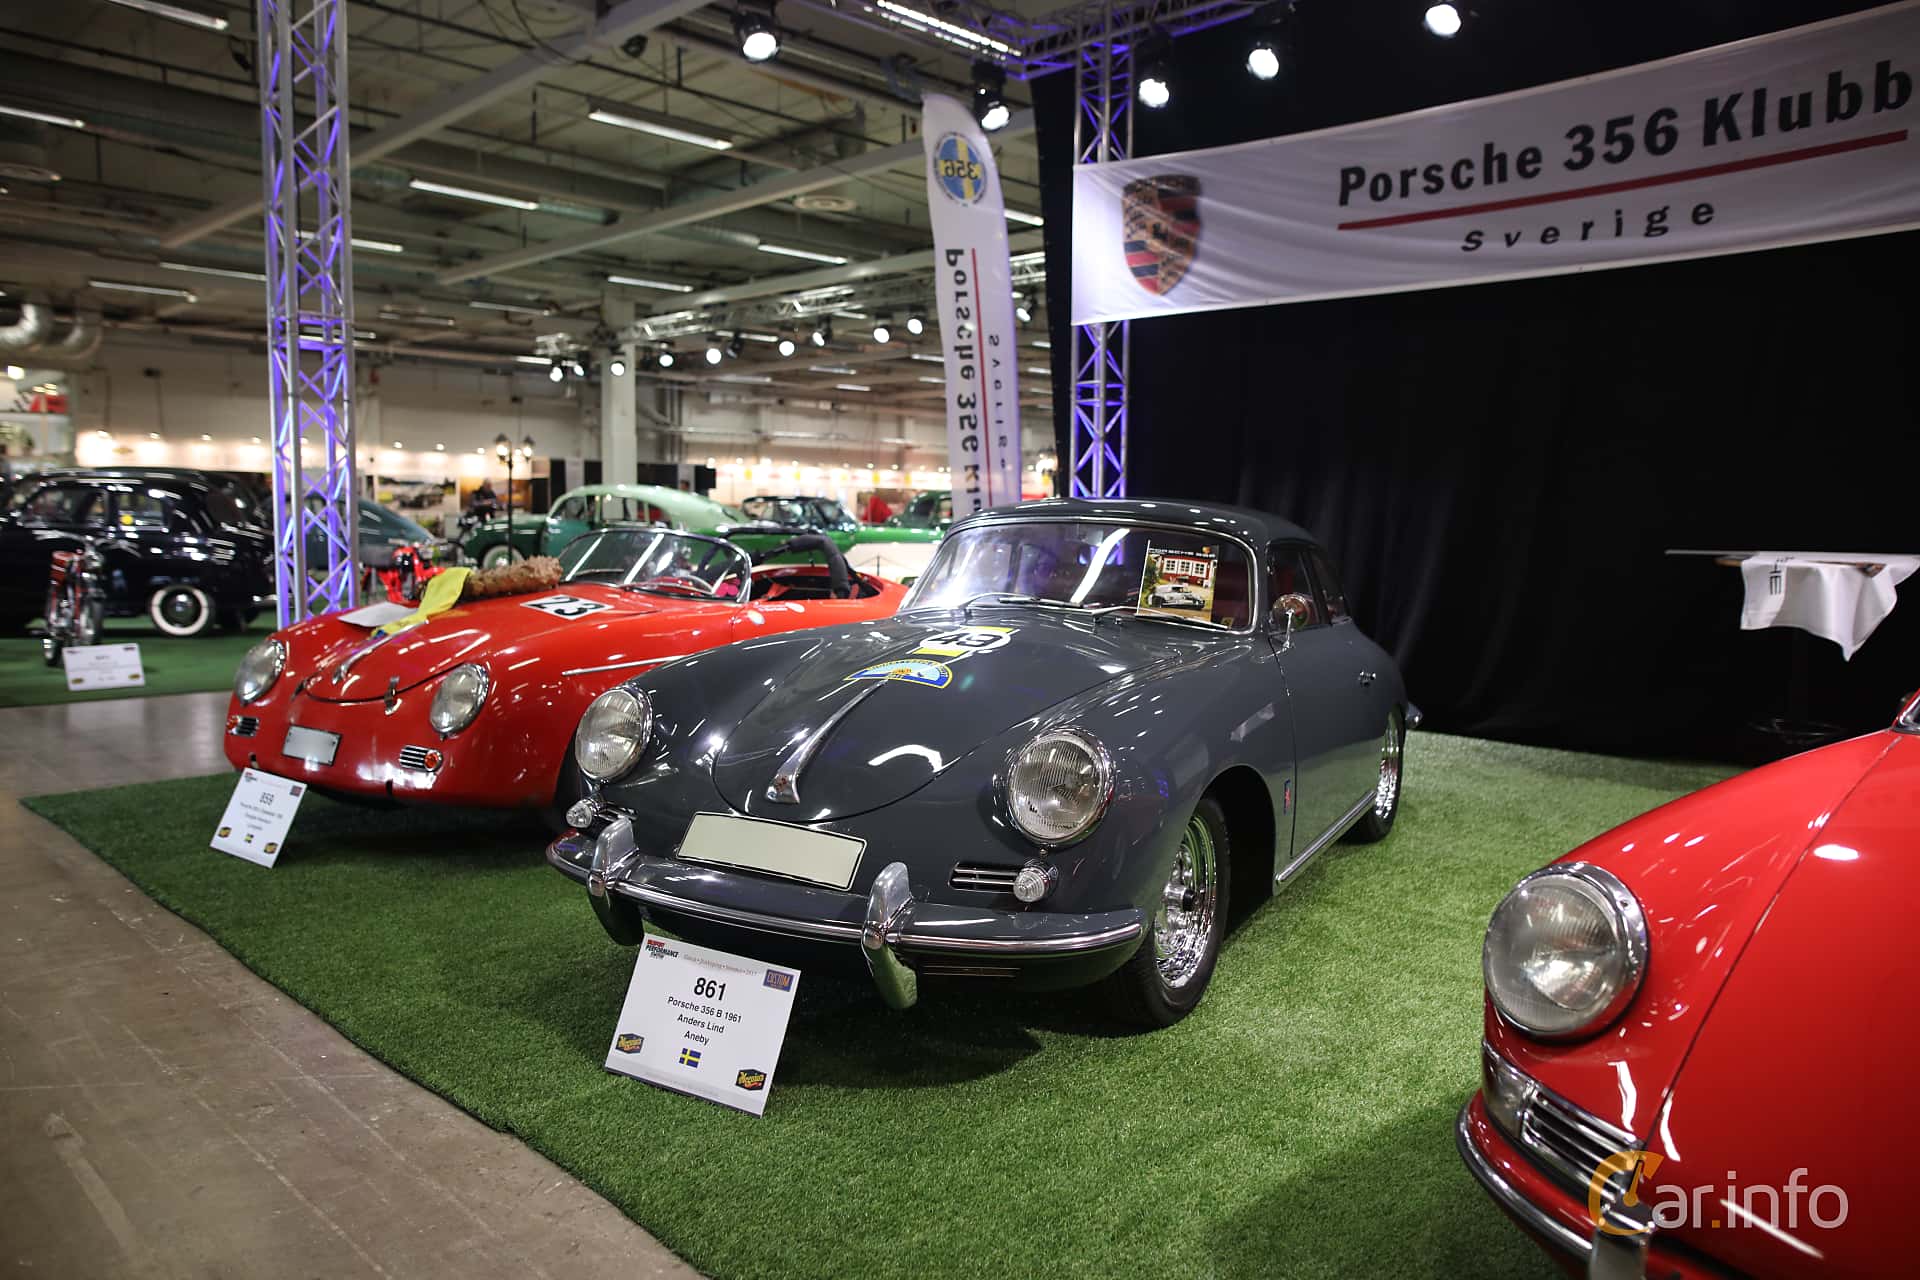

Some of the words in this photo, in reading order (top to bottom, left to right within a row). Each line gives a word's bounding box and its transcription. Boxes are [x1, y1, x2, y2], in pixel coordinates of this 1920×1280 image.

[1338, 141, 1543, 206] Porsche
[1563, 106, 1679, 172] 356
[1703, 60, 1913, 147] Klubb
[527, 596, 606, 616] 23
[693, 977, 726, 1001] 861
[667, 996, 700, 1012] Porsche
[700, 1005, 715, 1016] 356
[716, 1009, 722, 1018] B
[724, 1012, 742, 1023] 1961
[677, 1013, 706, 1029] Anders
[706, 1021, 725, 1034] Lind
[684, 1030, 710, 1046] Aneby
